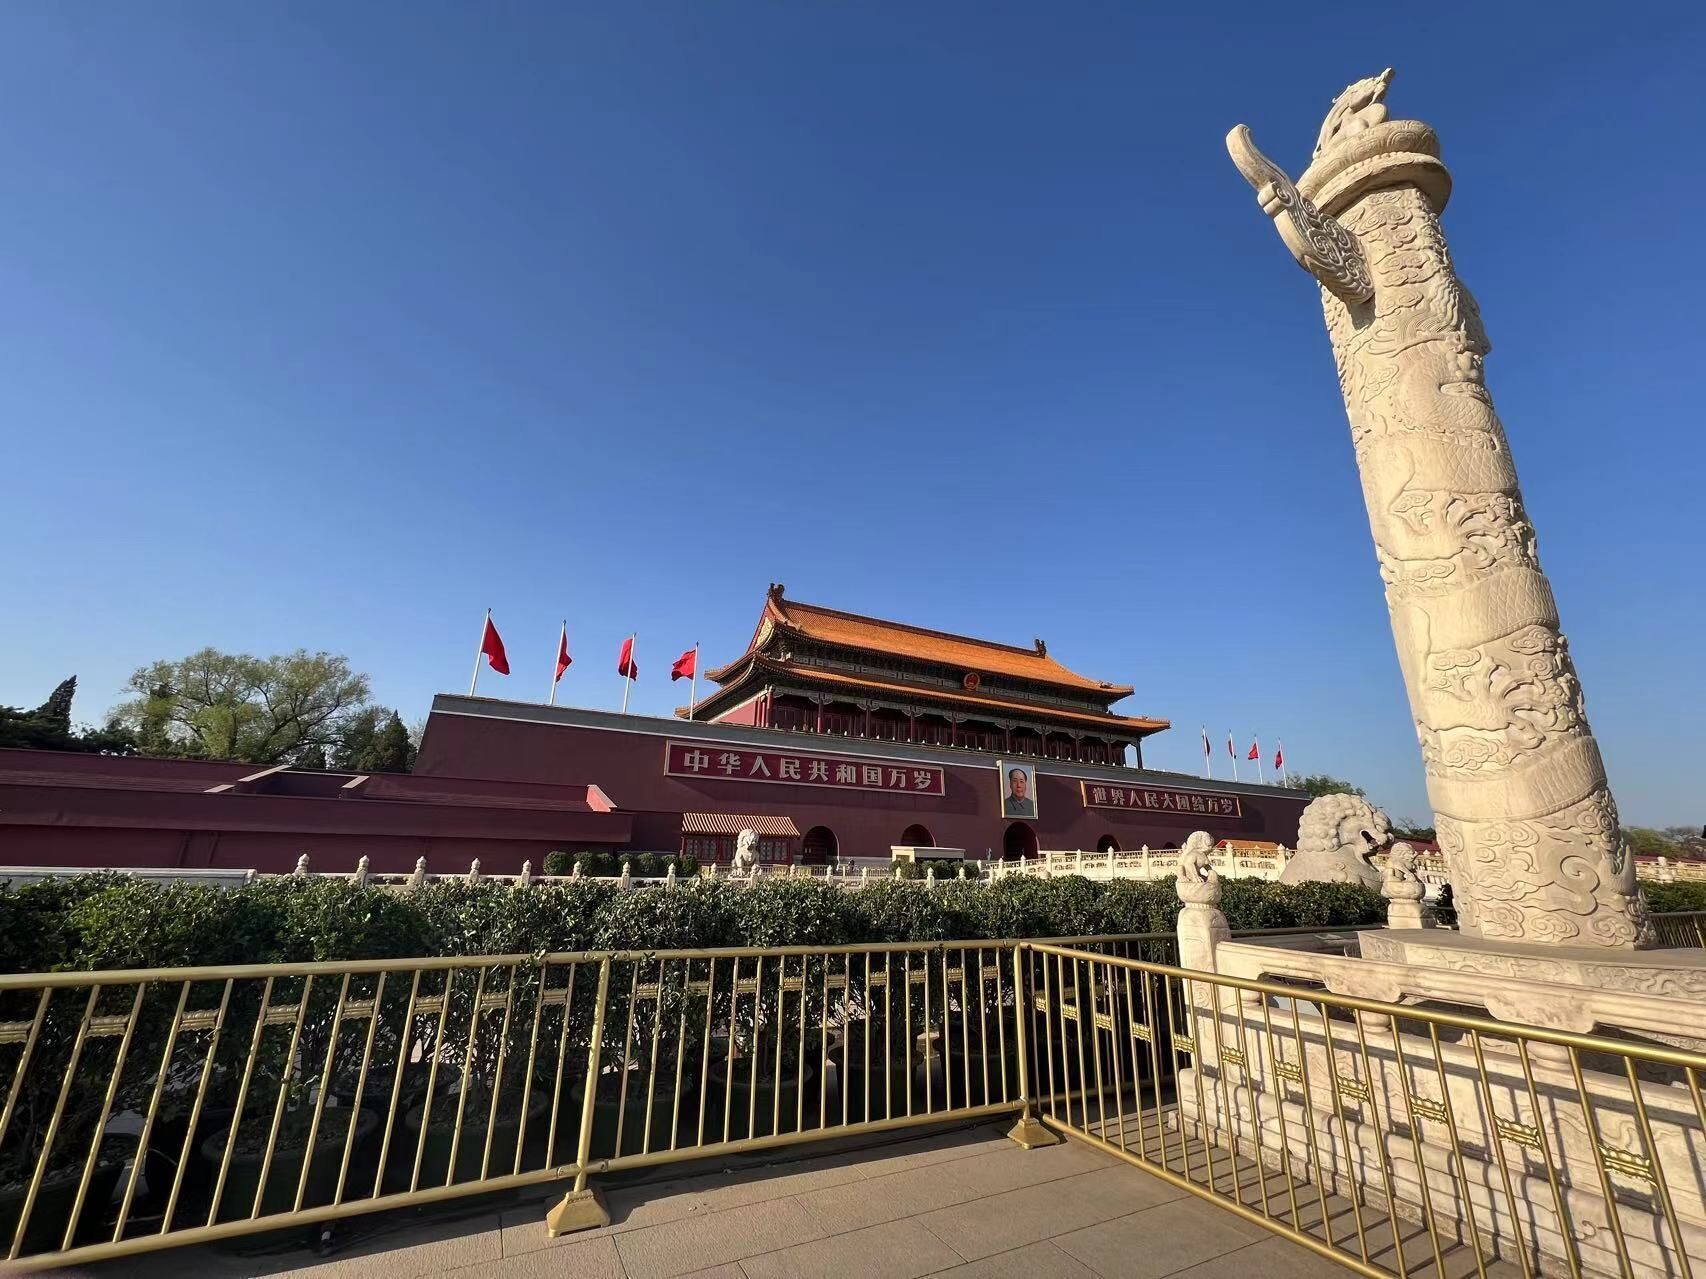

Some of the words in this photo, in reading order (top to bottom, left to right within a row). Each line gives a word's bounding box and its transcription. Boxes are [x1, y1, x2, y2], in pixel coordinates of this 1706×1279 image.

[684, 750, 932, 789] 中华人民共和国万岁
[1093, 787, 1233, 814] 世界人民大团结万岁
